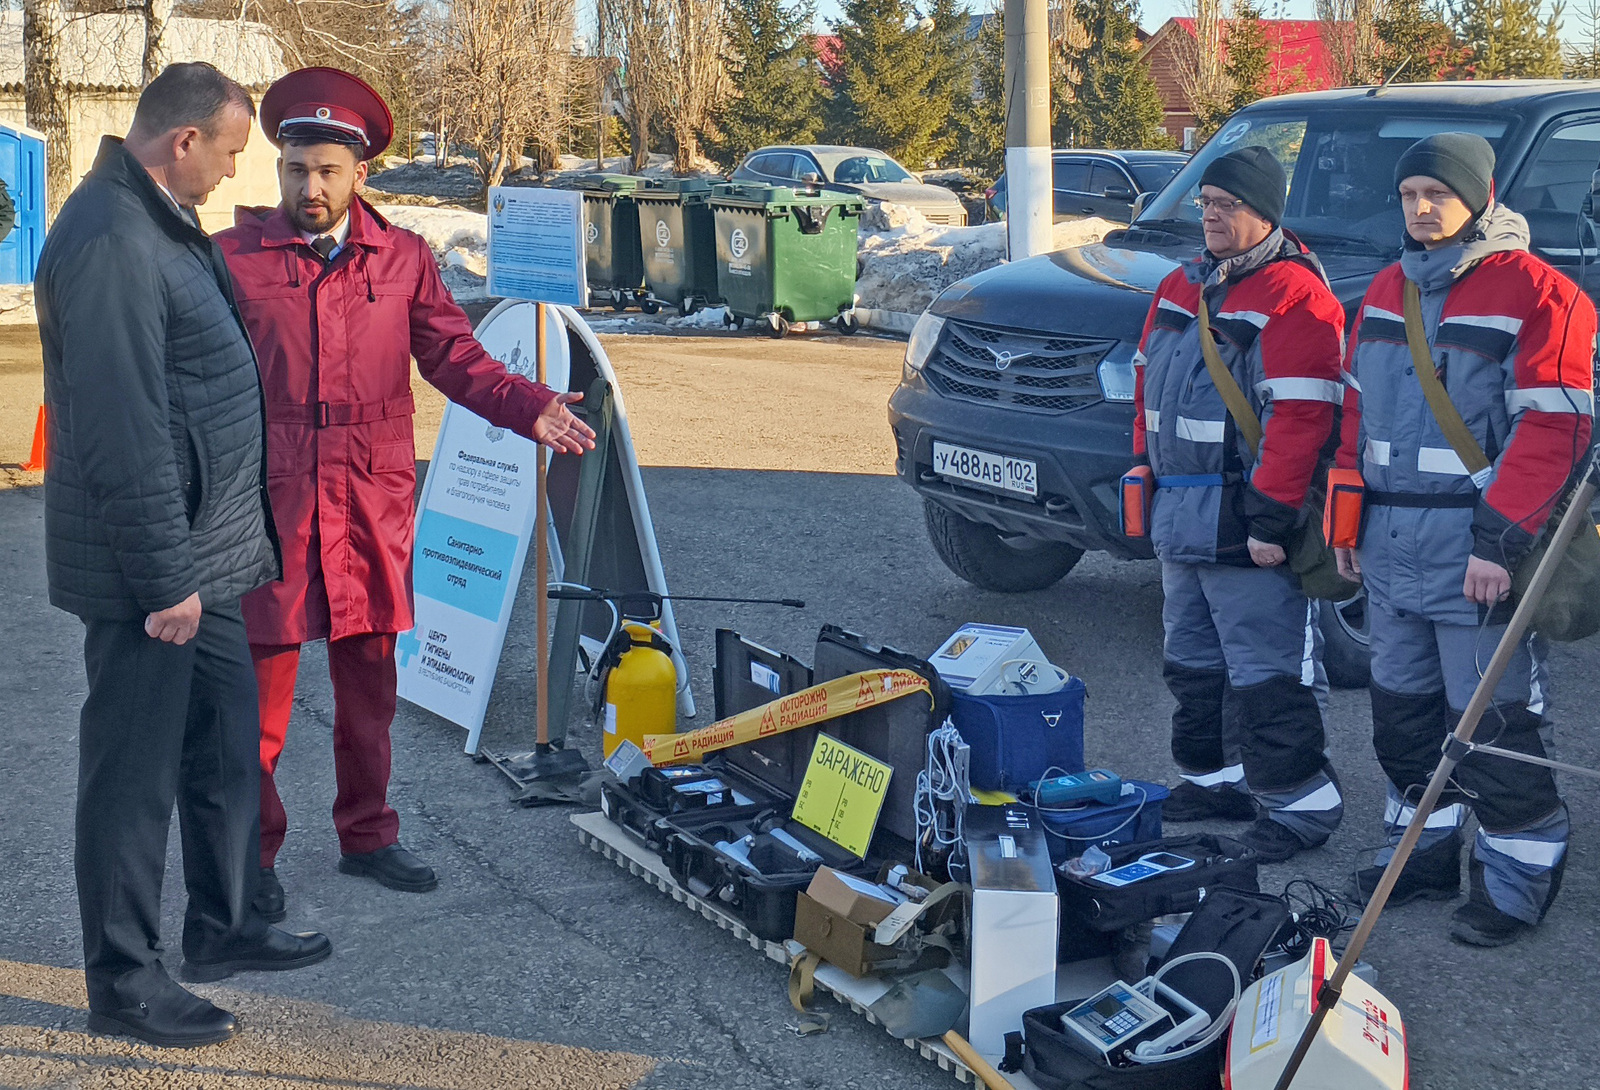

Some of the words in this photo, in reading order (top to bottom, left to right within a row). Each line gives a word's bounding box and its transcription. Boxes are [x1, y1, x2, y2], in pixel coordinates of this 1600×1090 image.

[457, 450, 497, 467] Федеральная
[497, 461, 519, 473] служба
[940, 450, 1002, 483] У488АВ
[1006, 460, 1032, 483] 102
[1012, 480, 1025, 490] RUS
[486, 497, 511, 511] человека
[447, 536, 485, 556] Санитарно-
[422, 547, 502, 580] противоэпидемический
[447, 573, 467, 588] отряд
[428, 629, 448, 643] ЦЕНТР
[424, 642, 452, 660] ГИГИЕНЫ
[426, 656, 475, 685] ЭПИДЕМИОЛОГИИ
[780, 687, 827, 713] ОСТОРОЖНО
[780, 703, 828, 726] РАДИАЦИЯ
[692, 730, 734, 750] РАДИАЦИЯ
[816, 742, 886, 794] ЗАРАЖЕНО
